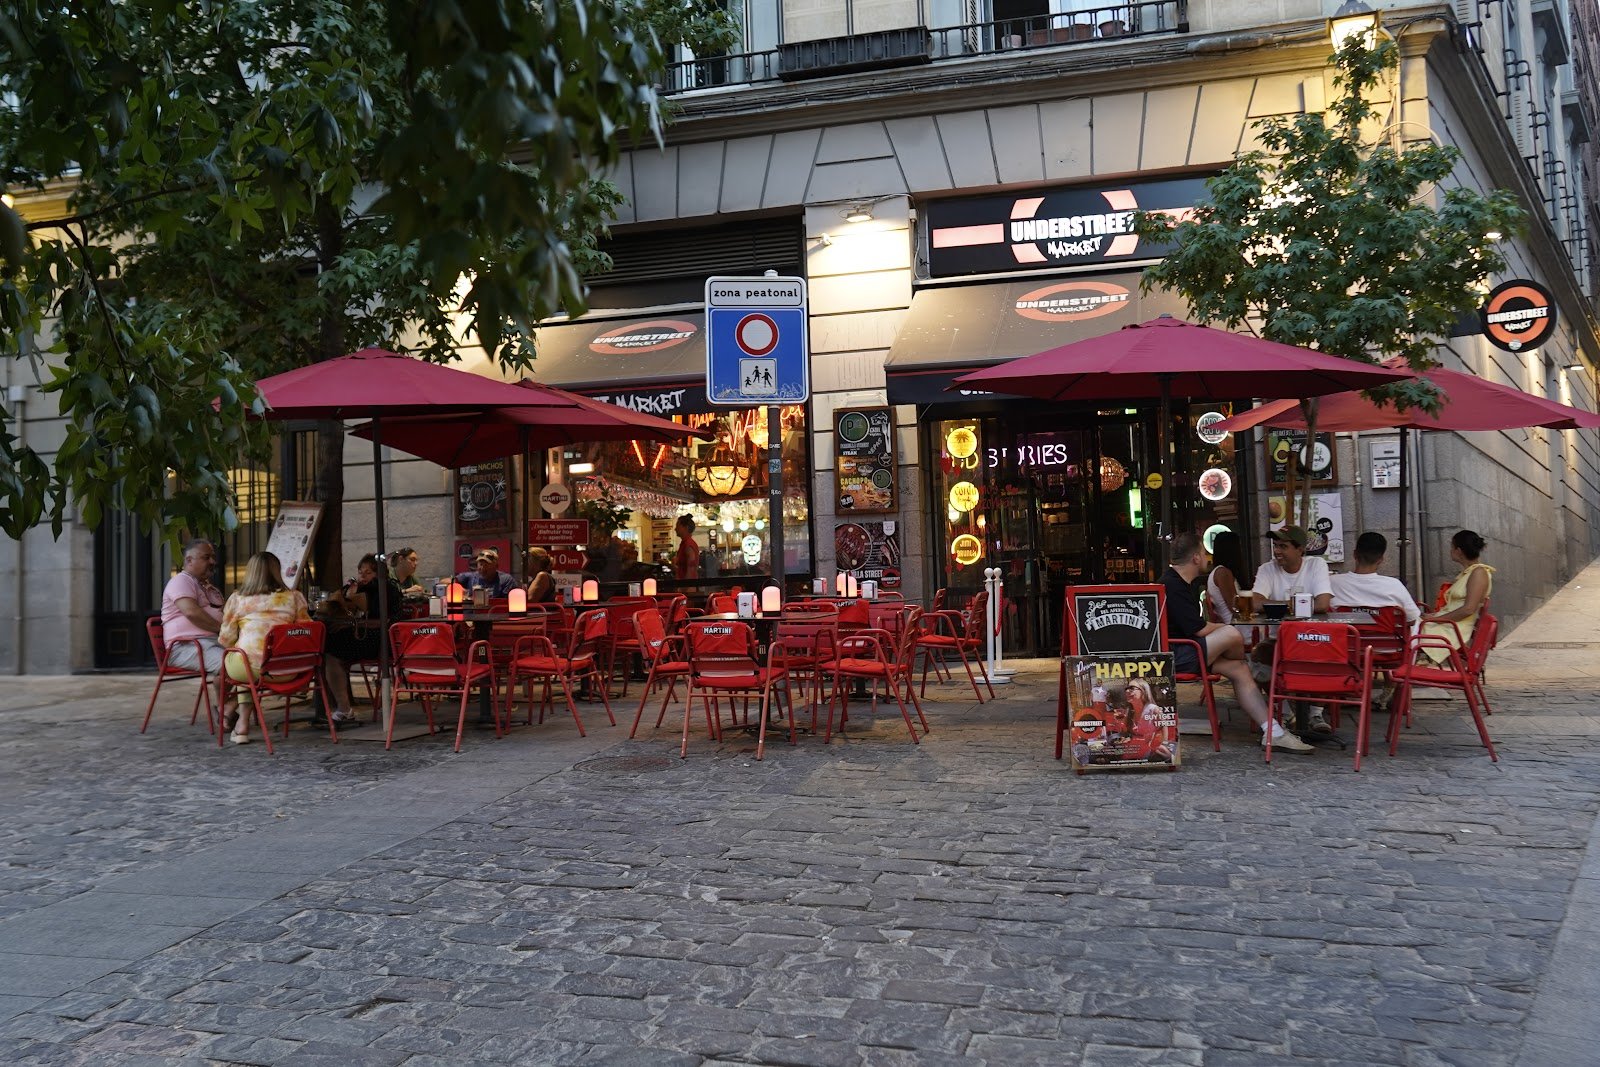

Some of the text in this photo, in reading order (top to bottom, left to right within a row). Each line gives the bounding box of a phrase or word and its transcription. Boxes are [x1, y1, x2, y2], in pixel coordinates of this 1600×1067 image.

[1047, 236, 1103, 259] MARKET
[746, 288, 798, 299] peatonal
[1016, 294, 1129, 309] UNDERSTREET
[1047, 304, 1097, 313] MARKET
[1487, 307, 1548, 323] UNDERSTREET
[593, 331, 695, 344] UNDERSTREET
[616, 389, 686, 413] MARKET
[478, 461, 504, 471] NACHOS
[864, 569, 883, 578] STREET
[1096, 614, 1139, 628] MARTINI
[287, 628, 311, 636] MARTINI
[412, 627, 438, 636] MARTINI
[1297, 633, 1331, 642] MARTINI
[1095, 660, 1166, 679] HAPPY
